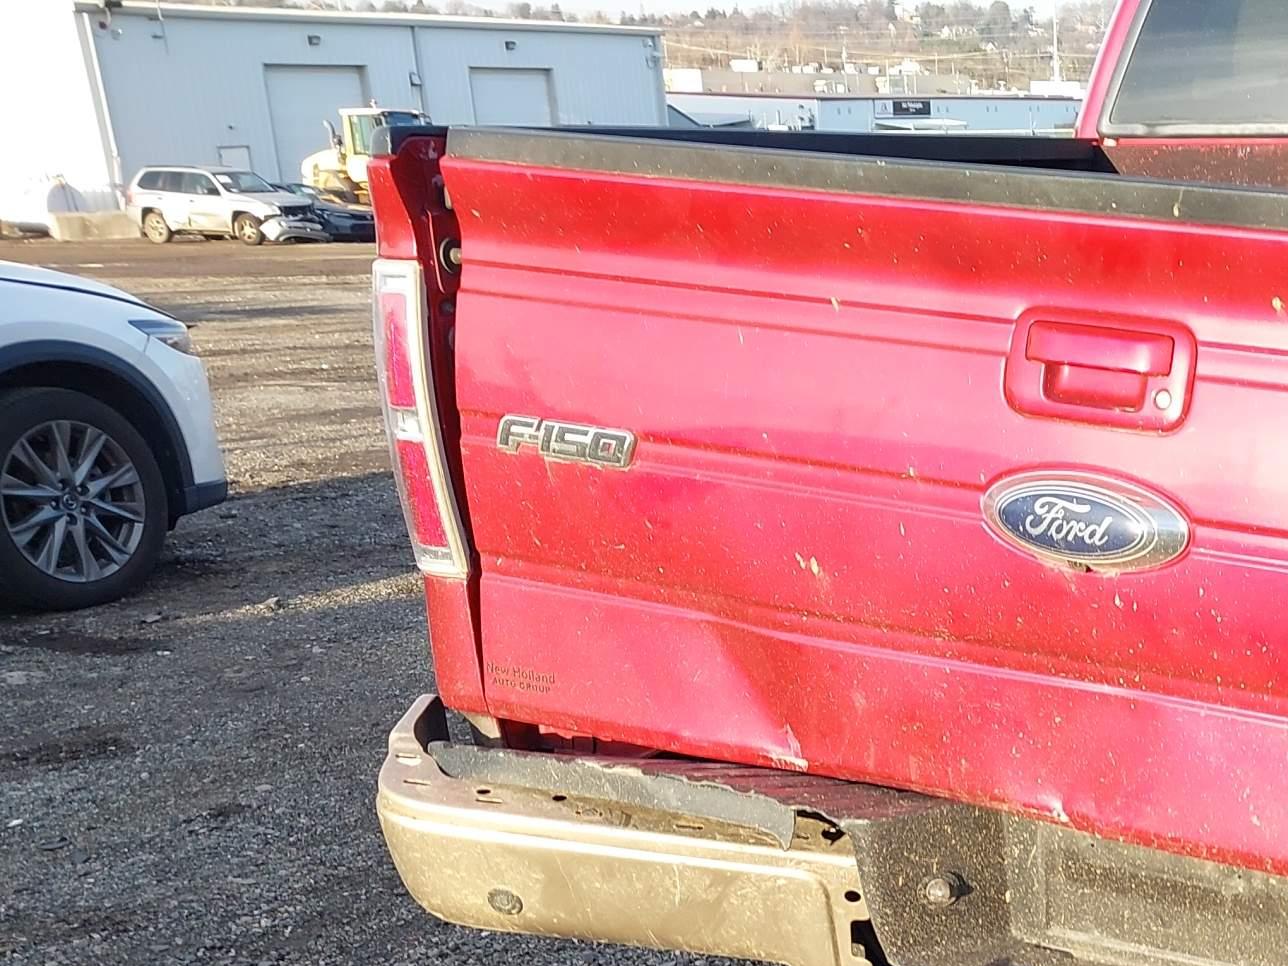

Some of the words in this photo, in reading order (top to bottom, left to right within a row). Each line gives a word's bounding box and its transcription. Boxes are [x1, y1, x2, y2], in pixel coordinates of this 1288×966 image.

[497, 414, 637, 470] F-150
[1026, 496, 1113, 545] Ford
[487, 662, 509, 676] New
[513, 667, 555, 684] Holland
